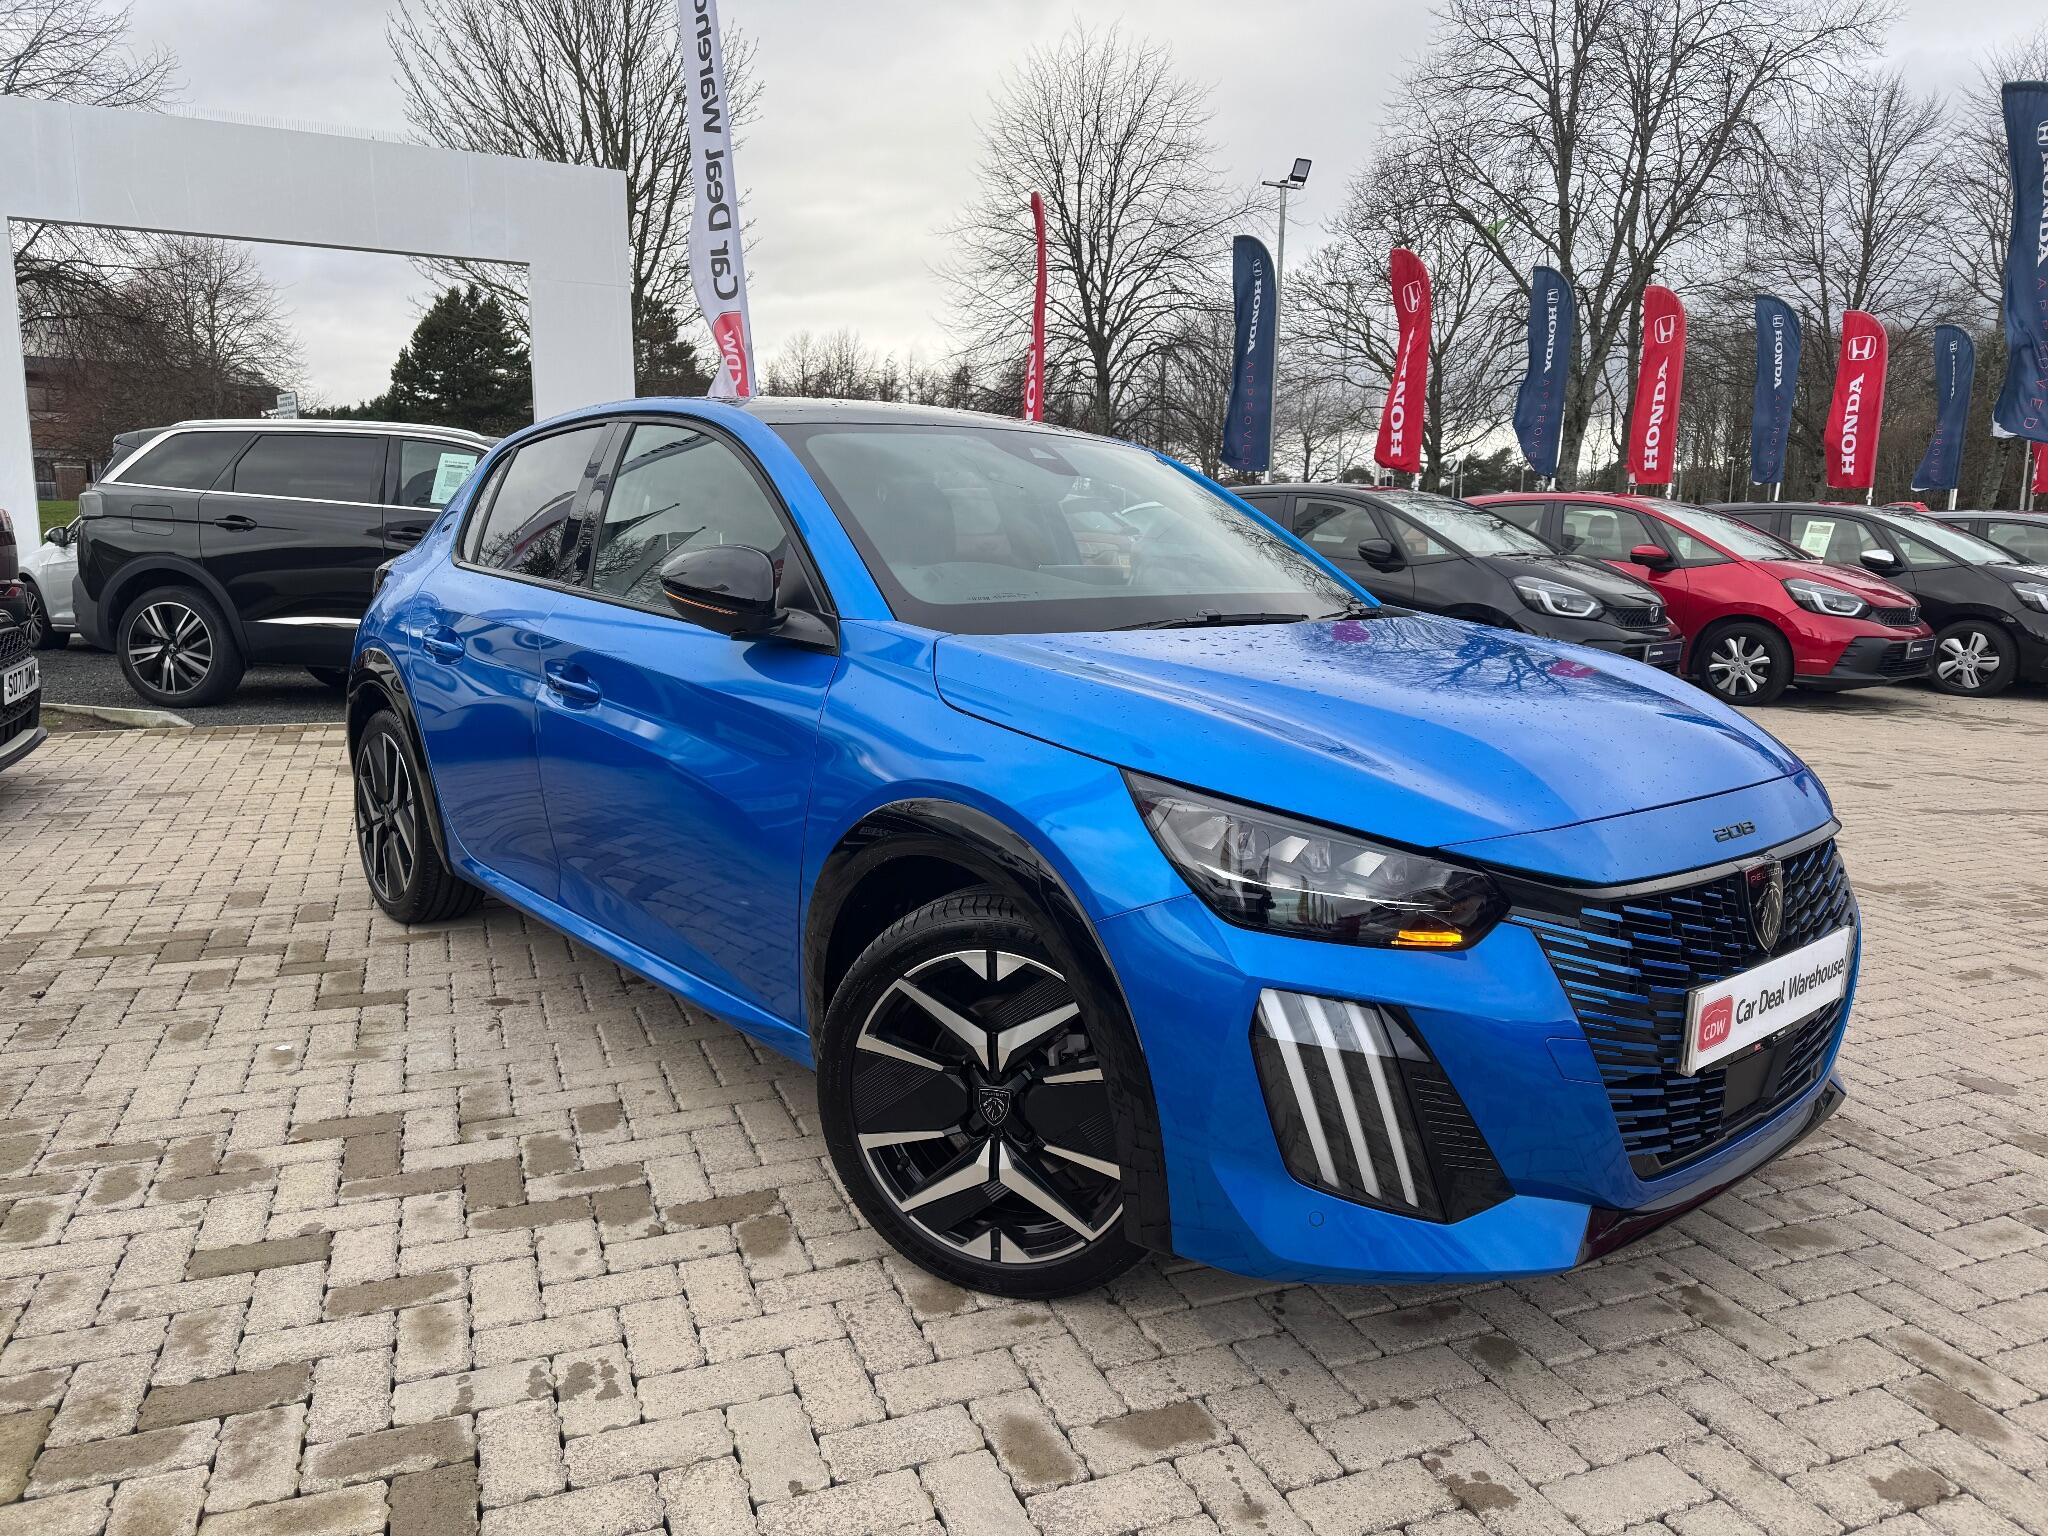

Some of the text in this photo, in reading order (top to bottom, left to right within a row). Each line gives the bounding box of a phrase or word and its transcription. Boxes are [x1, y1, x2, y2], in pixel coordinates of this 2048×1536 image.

[1247, 278, 1262, 355] HONDA
[1544, 305, 1558, 374] HONDA
[1774, 329, 1783, 390] HONDA
[1643, 356, 1669, 471] HONDA
[1841, 373, 1865, 475] HONDA
[1713, 821, 1756, 842] 208
[1736, 960, 1845, 1024] Car Deal Warehouse
[1703, 1018, 1727, 1041] CDW
